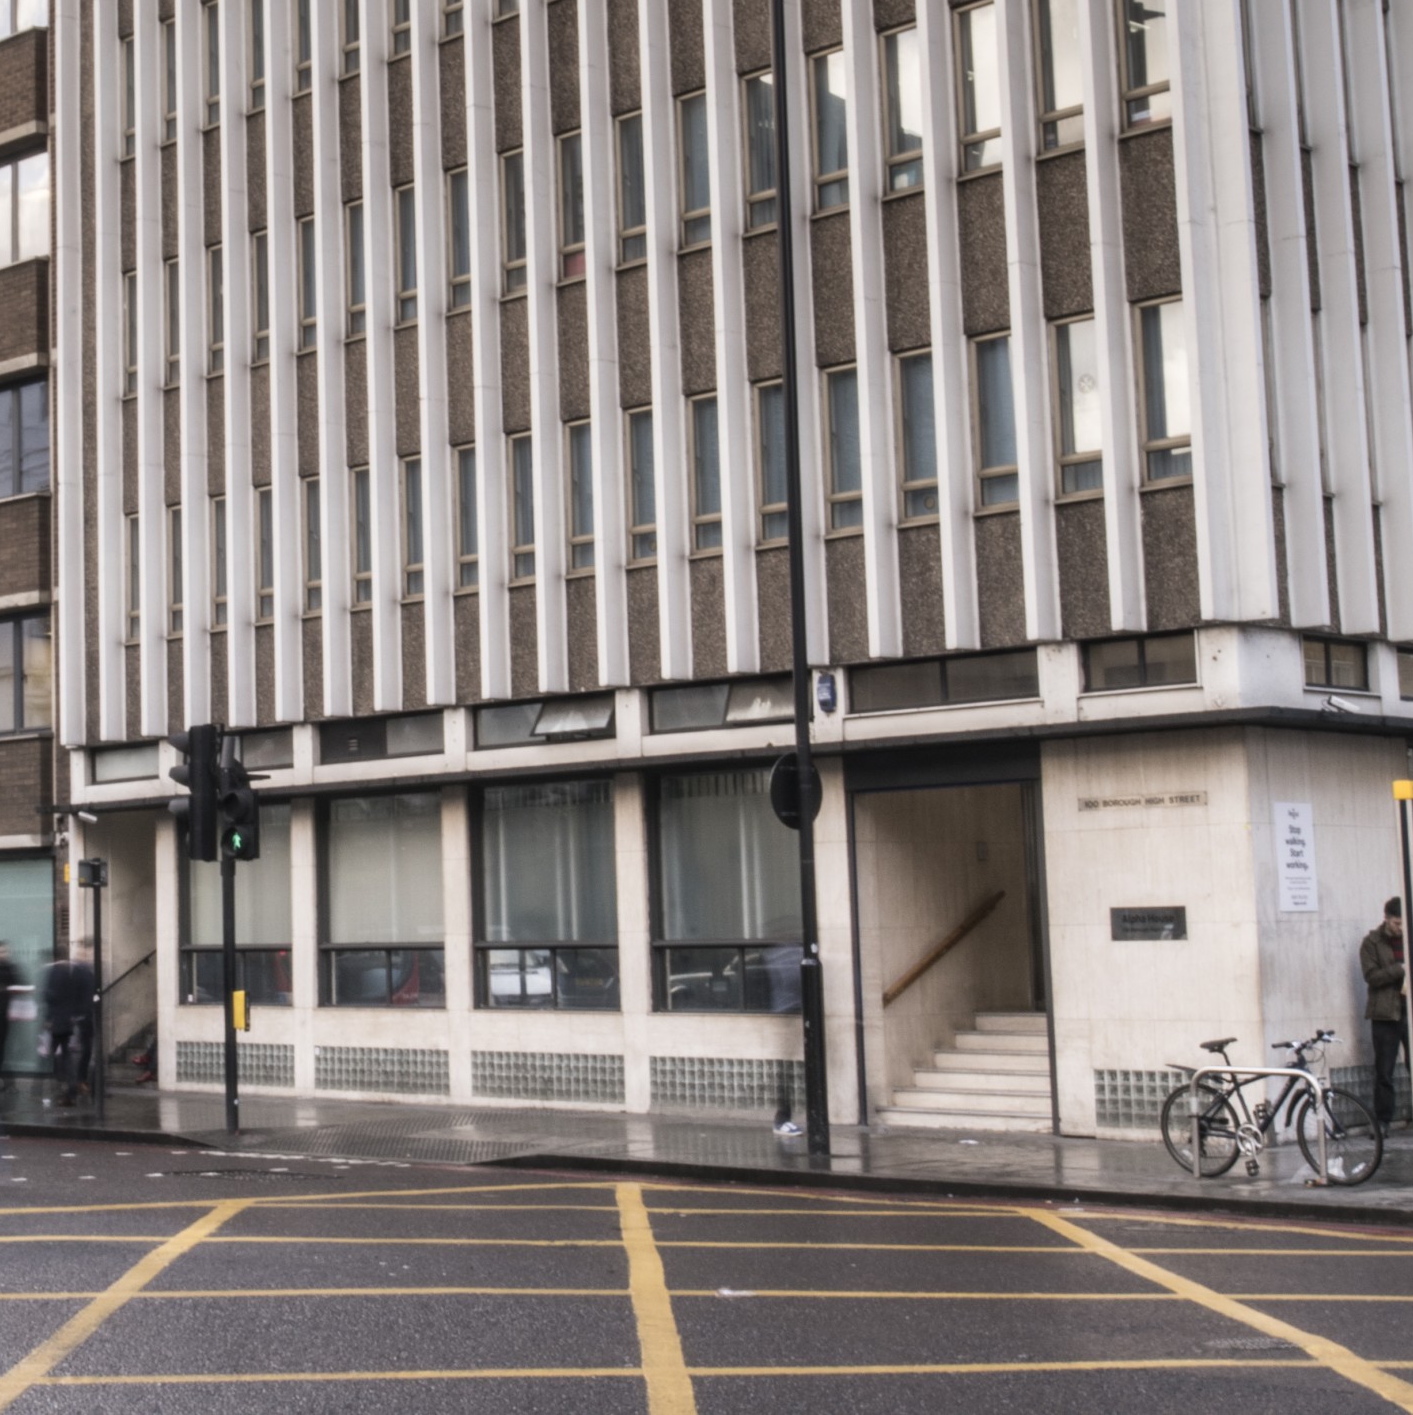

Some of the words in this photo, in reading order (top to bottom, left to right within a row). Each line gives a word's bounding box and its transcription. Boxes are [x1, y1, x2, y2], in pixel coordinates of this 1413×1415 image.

[1102, 798, 1141, 807] BOROUGH
[1145, 796, 1165, 805] HIGH
[1169, 794, 1200, 804] STREET
